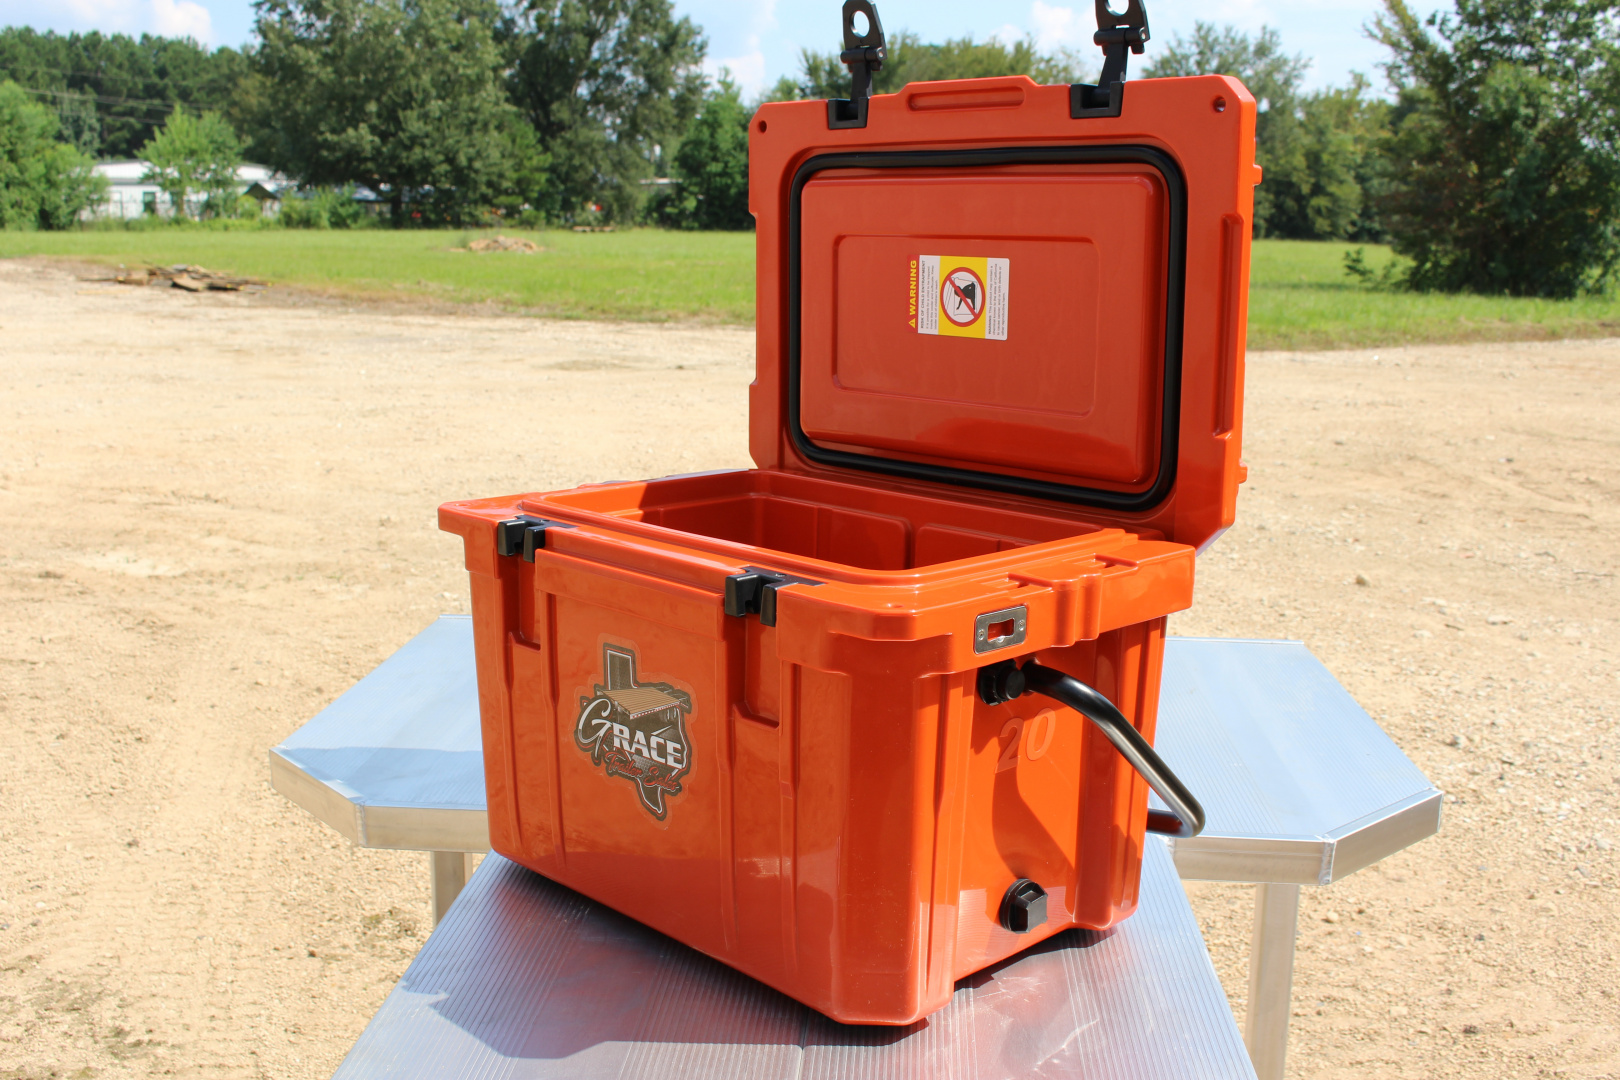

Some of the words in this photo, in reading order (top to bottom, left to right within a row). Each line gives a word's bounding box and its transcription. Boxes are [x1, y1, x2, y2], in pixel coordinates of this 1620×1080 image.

[909, 260, 917, 315] WARNING
[578, 698, 683, 769] GRACE
[995, 707, 1056, 773] 20
[605, 751, 643, 777] Trailer
[643, 766, 679, 791] Sales
